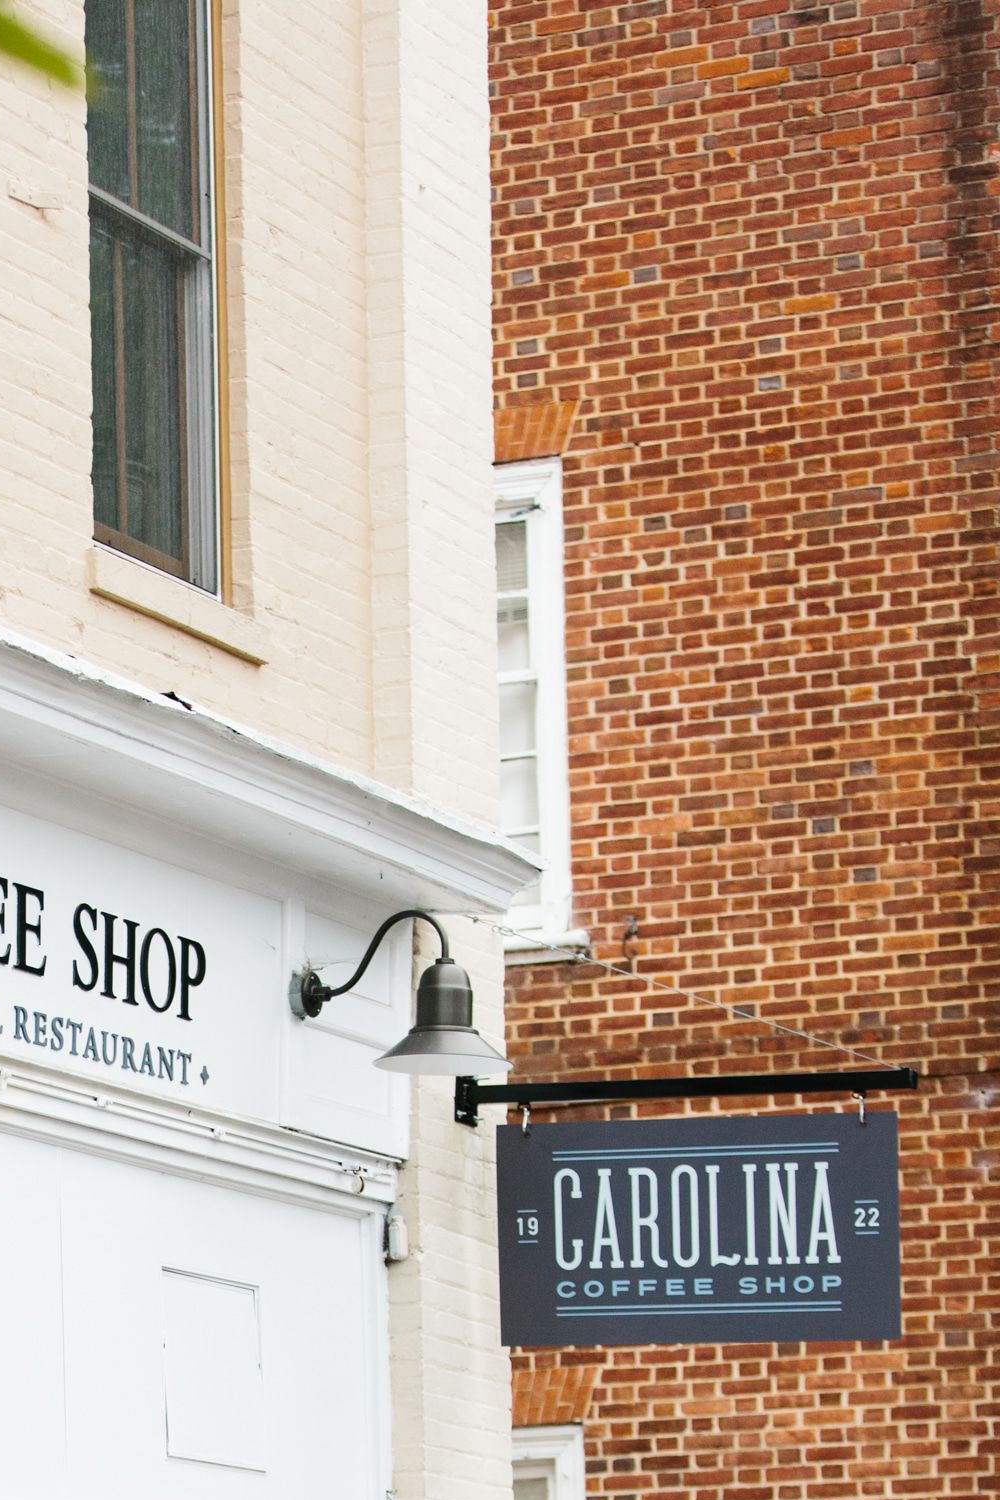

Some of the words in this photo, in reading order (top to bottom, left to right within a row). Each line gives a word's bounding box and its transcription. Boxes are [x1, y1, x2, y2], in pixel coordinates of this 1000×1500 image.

[73, 903, 206, 1021] SHOP
[14, 1006, 192, 1085] RESTAURANT
[516, 1217, 539, 1236] 19
[553, 1161, 842, 1271] CAROLINA
[854, 1207, 880, 1228] 22
[556, 1278, 714, 1297] COFFEE
[739, 1275, 842, 1295] SHOP
